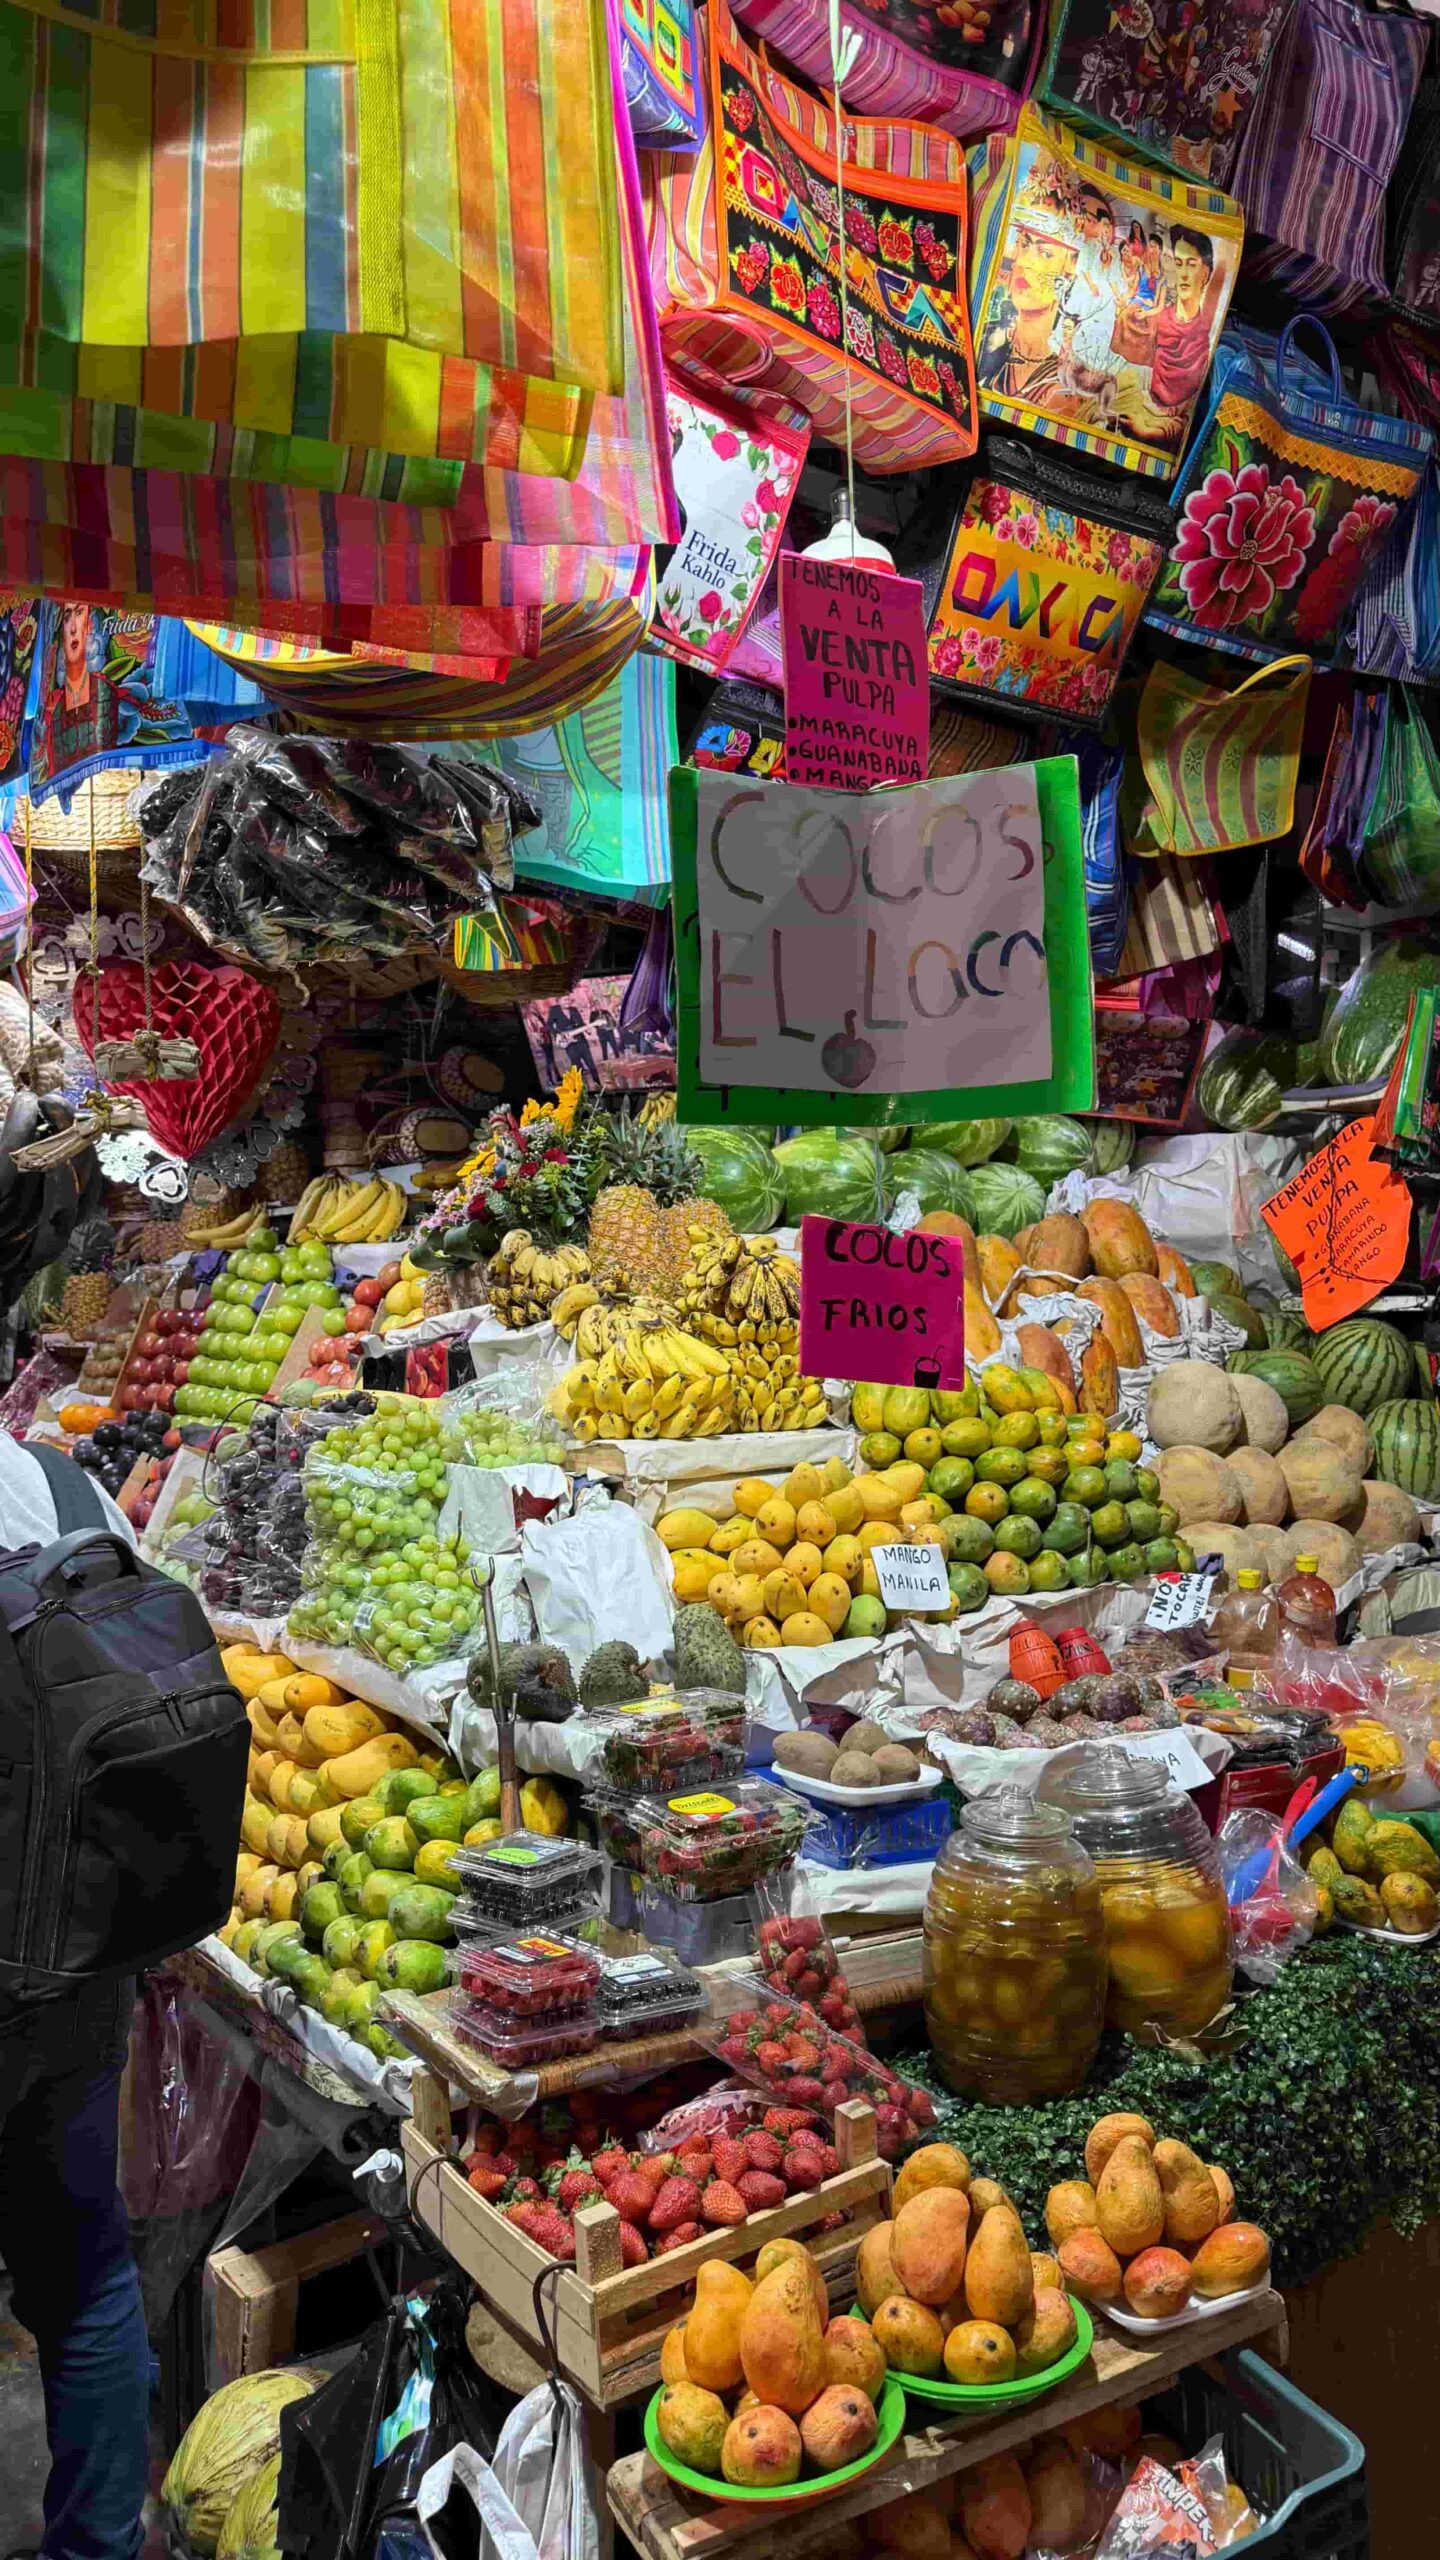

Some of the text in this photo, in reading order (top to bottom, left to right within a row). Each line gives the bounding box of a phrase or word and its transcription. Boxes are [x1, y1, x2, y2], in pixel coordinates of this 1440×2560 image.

[680, 553, 726, 590] Kahlo
[686, 529, 739, 576] Frida
[787, 558, 881, 604] TENEMOS
[828, 600, 884, 632] A LA
[800, 624, 916, 687] VENTA
[823, 671, 895, 716] PULPA
[800, 713, 918, 757] MARACUYA
[711, 791, 1040, 915] COCOS
[712, 928, 815, 1048] EL
[1261, 1156, 1327, 1218] TENEMOS
[1343, 1122, 1364, 1144] LA
[825, 1221, 951, 1278] COCOS
[819, 1298, 928, 1335] FRIOS
[882, 1546, 931, 1564] MANGO
[881, 1572, 941, 1592] MANILA
[1168, 1573, 1193, 1624] TOCAR
